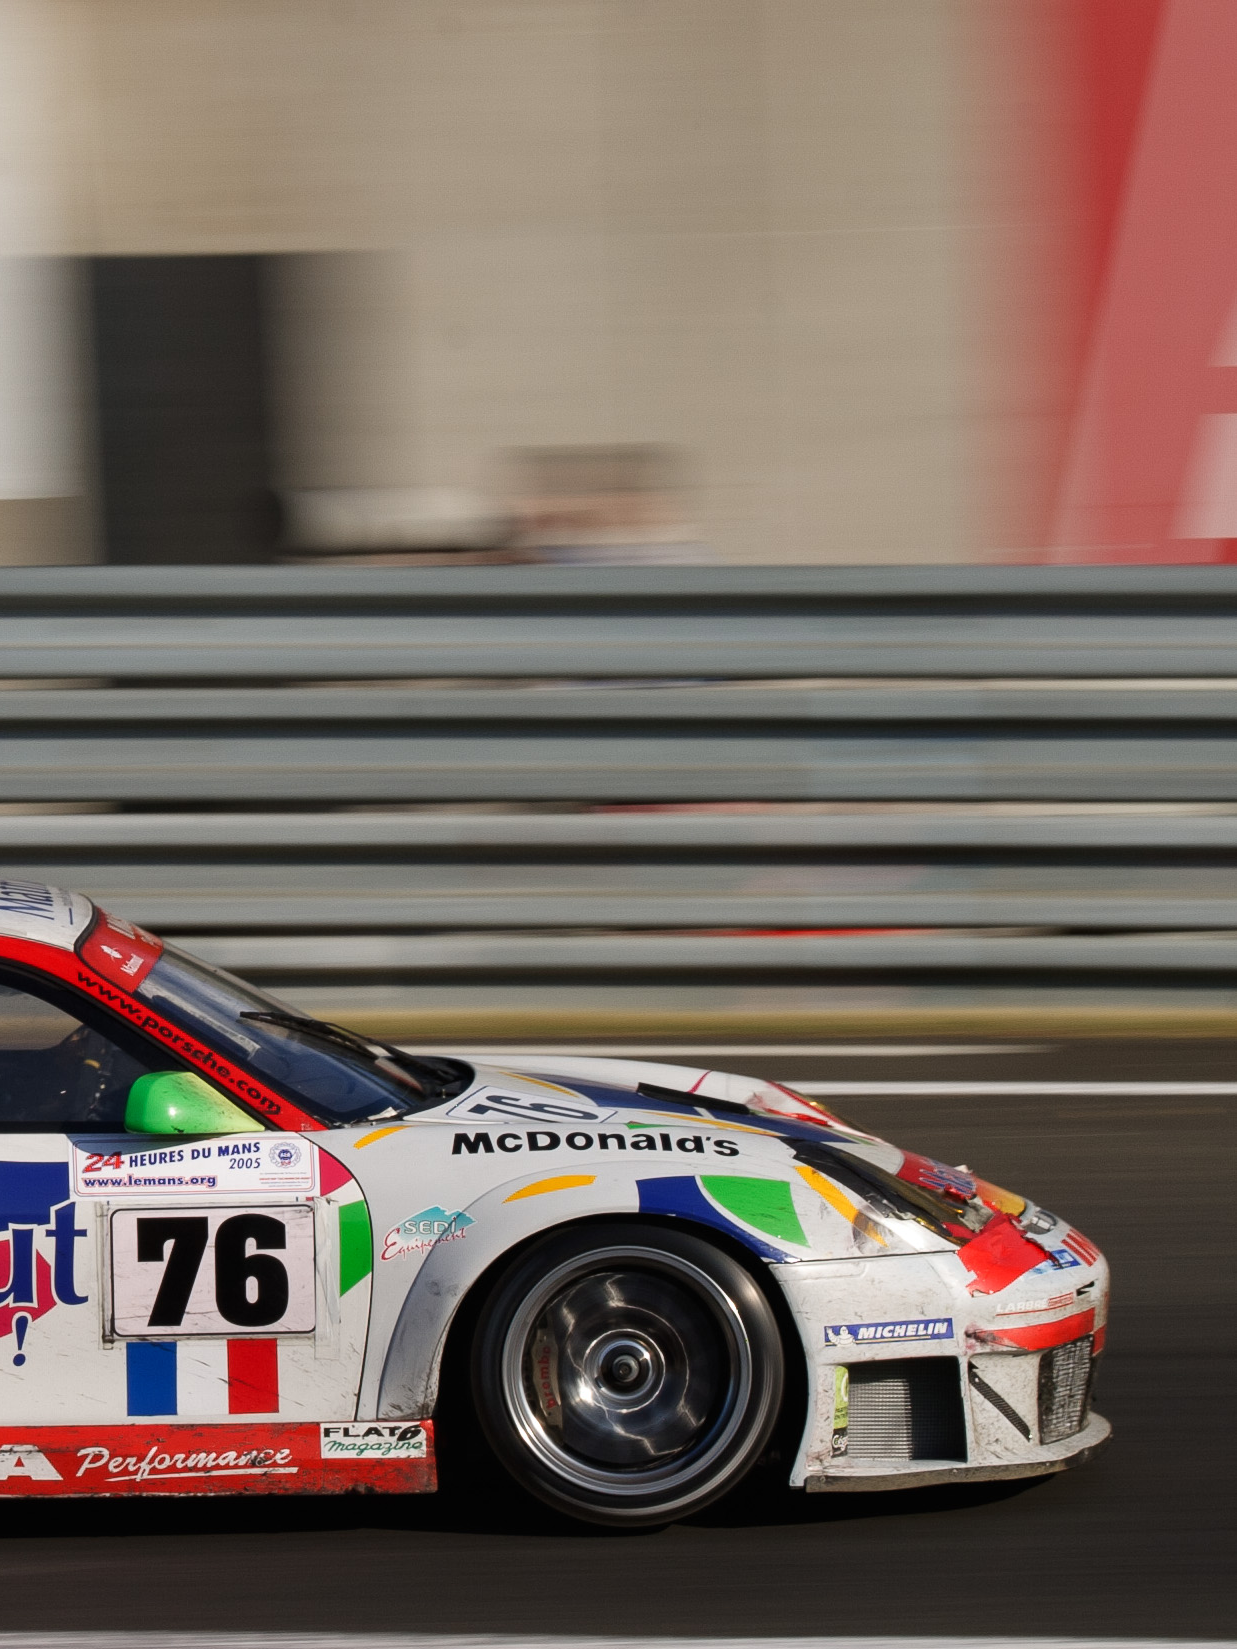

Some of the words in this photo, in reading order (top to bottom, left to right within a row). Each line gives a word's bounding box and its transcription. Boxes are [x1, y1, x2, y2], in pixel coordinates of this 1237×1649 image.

[77, 971, 283, 1116] www.porsche.com
[82, 1152, 124, 1173] 24
[129, 1150, 184, 1168] HEURES
[191, 1147, 212, 1160] DU
[218, 1142, 261, 1157] MANS
[452, 1131, 740, 1157] McDonald's
[229, 1158, 261, 1169] 2005
[83, 1175, 217, 1188] www.lemans.org
[136, 1213, 289, 1327] 76
[12, 1315, 29, 1366] !
[858, 1322, 948, 1339] MICHELIN
[538, 1346, 557, 1409] brembo
[76, 1445, 295, 1481] Performance
